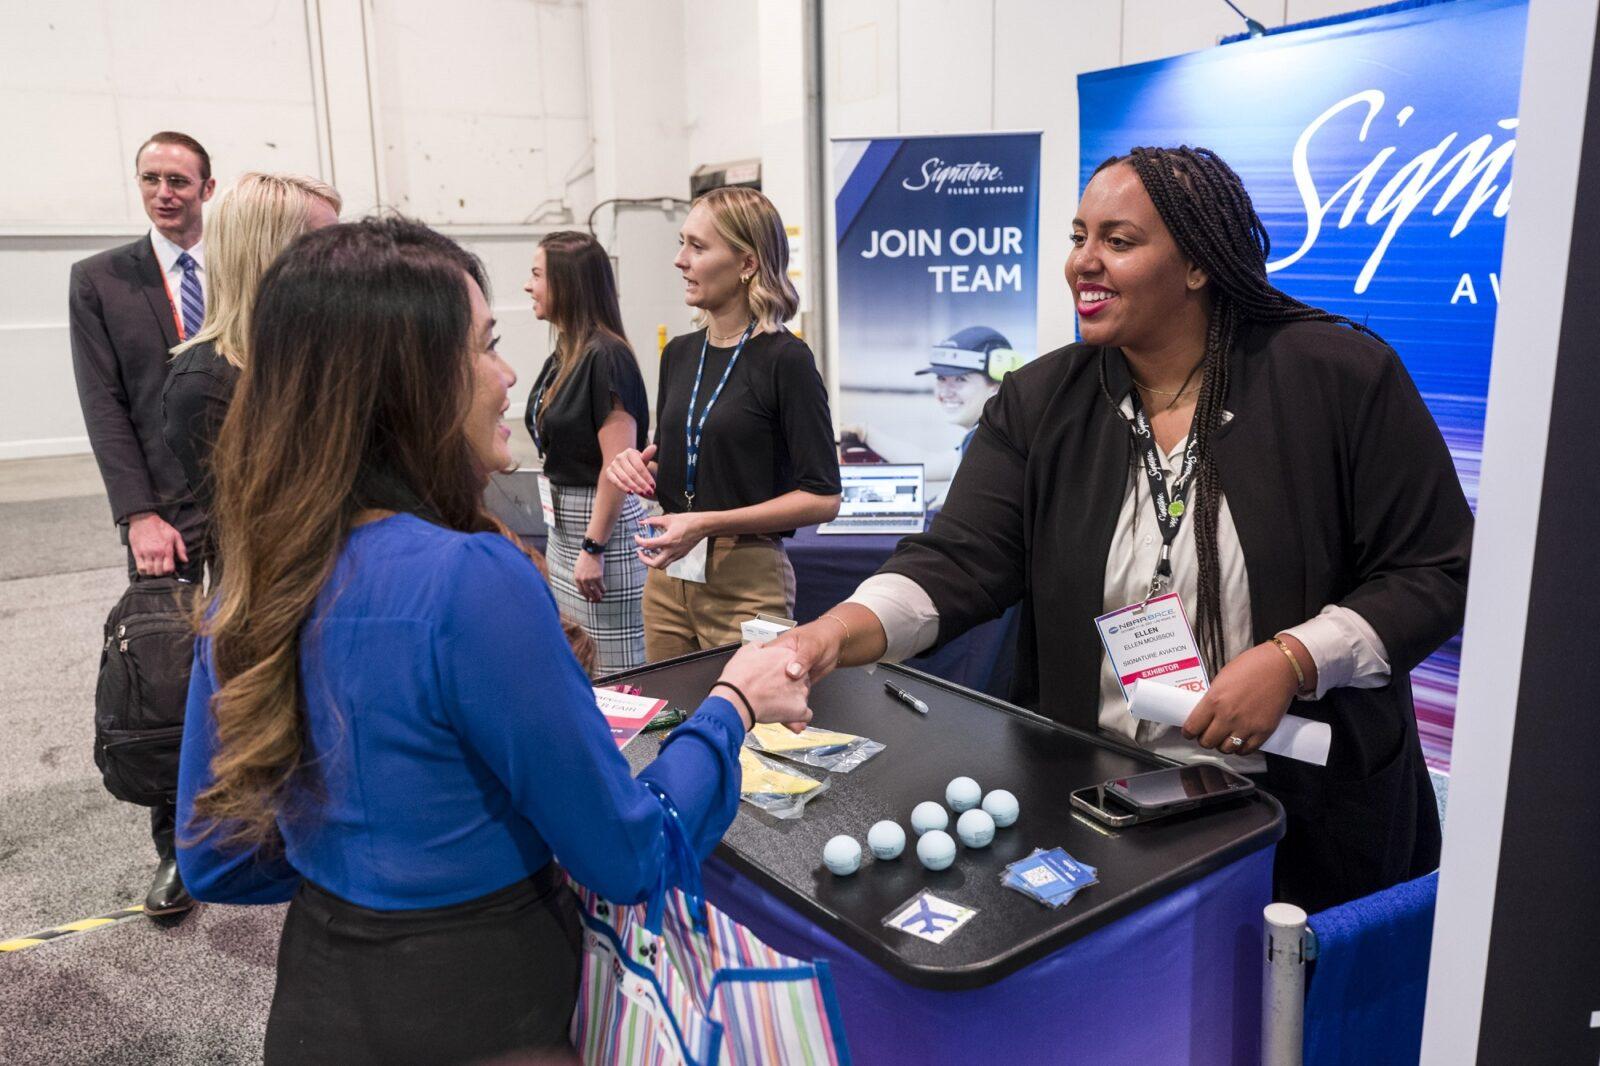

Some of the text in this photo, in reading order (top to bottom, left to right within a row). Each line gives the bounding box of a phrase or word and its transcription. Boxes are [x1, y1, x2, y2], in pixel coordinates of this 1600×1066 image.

[902, 157, 1001, 193] Signature
[947, 186, 1024, 195] FLIGHT SUPPORT
[1265, 89, 1519, 294] Sign
[861, 227, 1023, 259] JOIN OUR
[928, 264, 1022, 293] TEAM
[1134, 626, 1159, 639] ELLEN
[1123, 645, 1187, 667] SIGNATURE AVIATION
[1124, 639, 1144, 651] ELLEN
[1141, 663, 1180, 678] EXHIBITOR
